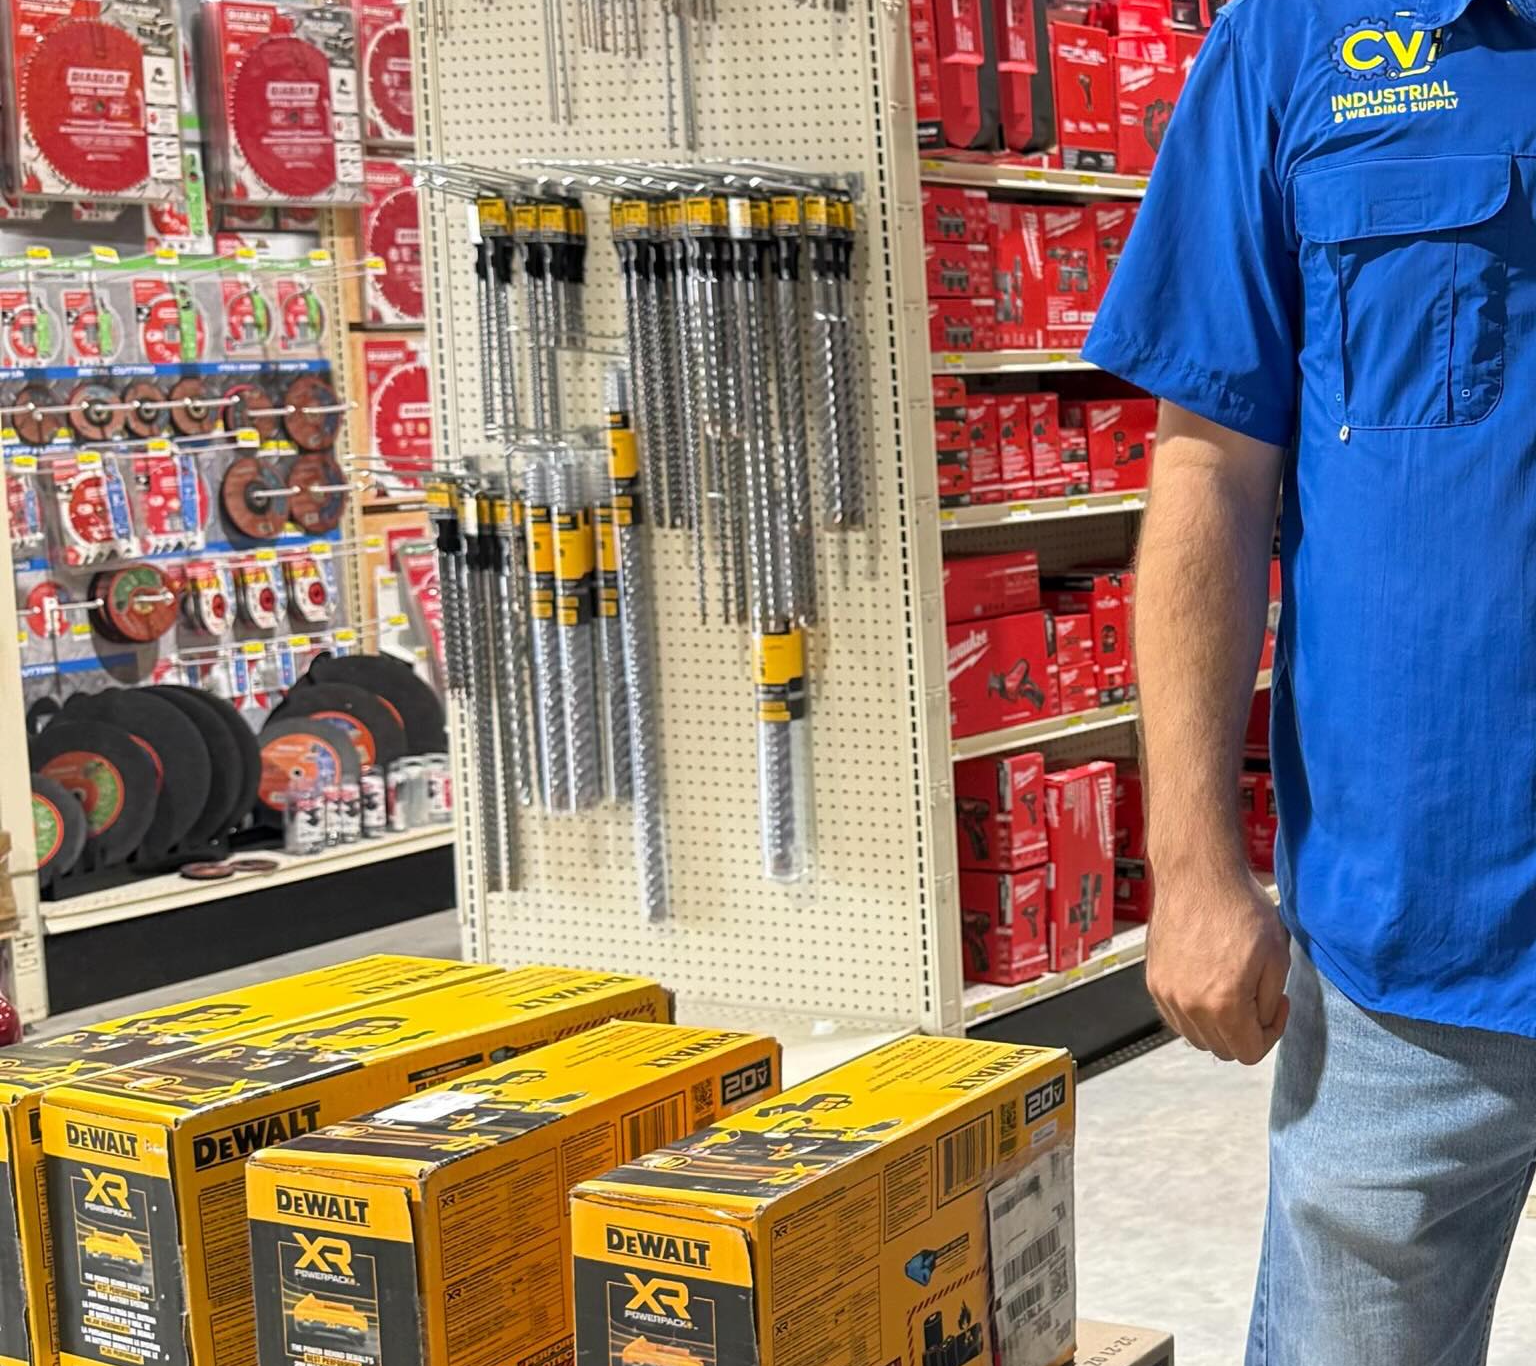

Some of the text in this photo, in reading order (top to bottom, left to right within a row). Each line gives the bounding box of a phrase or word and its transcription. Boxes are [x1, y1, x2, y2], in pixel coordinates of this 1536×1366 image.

[1331, 80, 1456, 112] INDUSTRIAL
[1334, 97, 1459, 123] & WELDING SUPPLY
[81, 1167, 131, 1211] XR
[292, 1232, 354, 1276] XR
[624, 1272, 692, 1320] XR
[624, 1309, 695, 1330] POWERPACK
